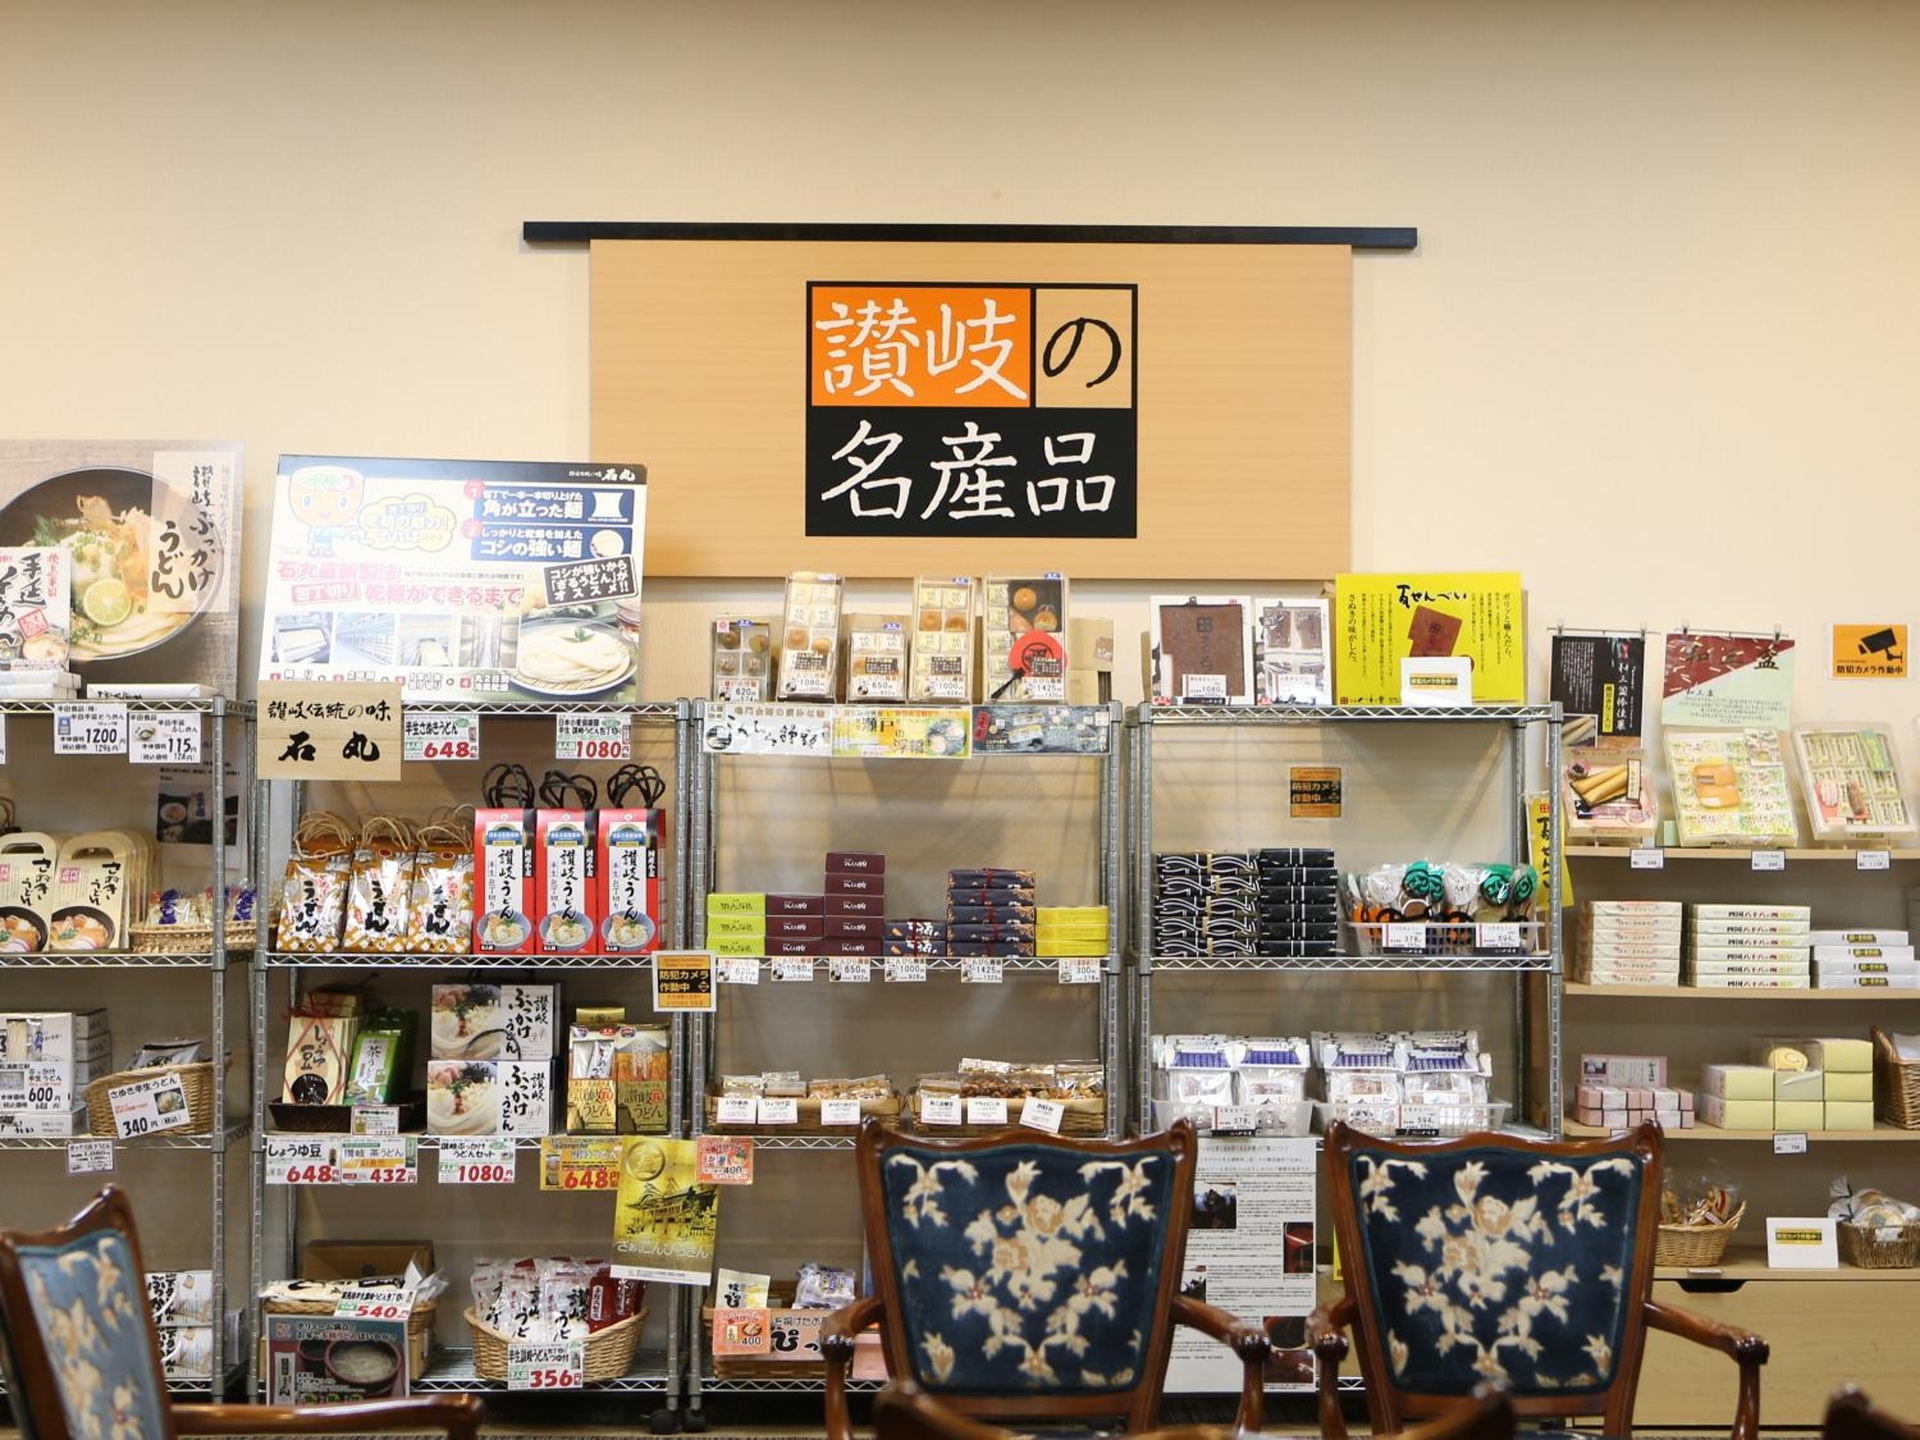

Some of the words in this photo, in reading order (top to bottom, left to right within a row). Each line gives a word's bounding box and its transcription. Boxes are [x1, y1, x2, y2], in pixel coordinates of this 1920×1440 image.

[821, 419, 1116, 520] 名産品
[481, 500, 583, 519] 角が立った麺
[479, 540, 583, 558] コシの強い麺
[152, 520, 184, 599] うどん
[1836, 665, 1903, 675] 防犯カメラ作動中
[267, 700, 392, 722] 讃岐伝統の味
[86, 728, 118, 744] 1200
[168, 738, 191, 753] 115
[278, 730, 381, 762] 石丸
[423, 741, 471, 759] 648
[576, 741, 622, 759] 1080
[1291, 782, 1341, 791] 防犯カメラ
[1291, 794, 1321, 803] 作動中
[497, 849, 516, 920] 讃岐うどん
[559, 849, 578, 920] 讃岐うどん
[621, 849, 640, 920] 讃岐うどん
[659, 970, 709, 979] 防犯カメラ
[660, 982, 690, 992] 作動中
[508, 988, 534, 1039] ぶっかけ
[29, 1087, 53, 1102] 600
[110, 1077, 177, 1099] さぬき半生うどん
[506, 1065, 530, 1116] ぶっかけ
[502, 1100, 515, 1132] うどん
[123, 1117, 148, 1136] 340
[268, 1143, 322, 1158] しょうゆ豆
[286, 1165, 331, 1182] 648
[370, 1168, 406, 1182] 432
[458, 1165, 504, 1181] 1080
[564, 1167, 609, 1189] 648
[723, 1165, 742, 1174] 400
[355, 1305, 398, 1318] 540
[741, 1337, 761, 1345] 400
[530, 1369, 572, 1387] 356
